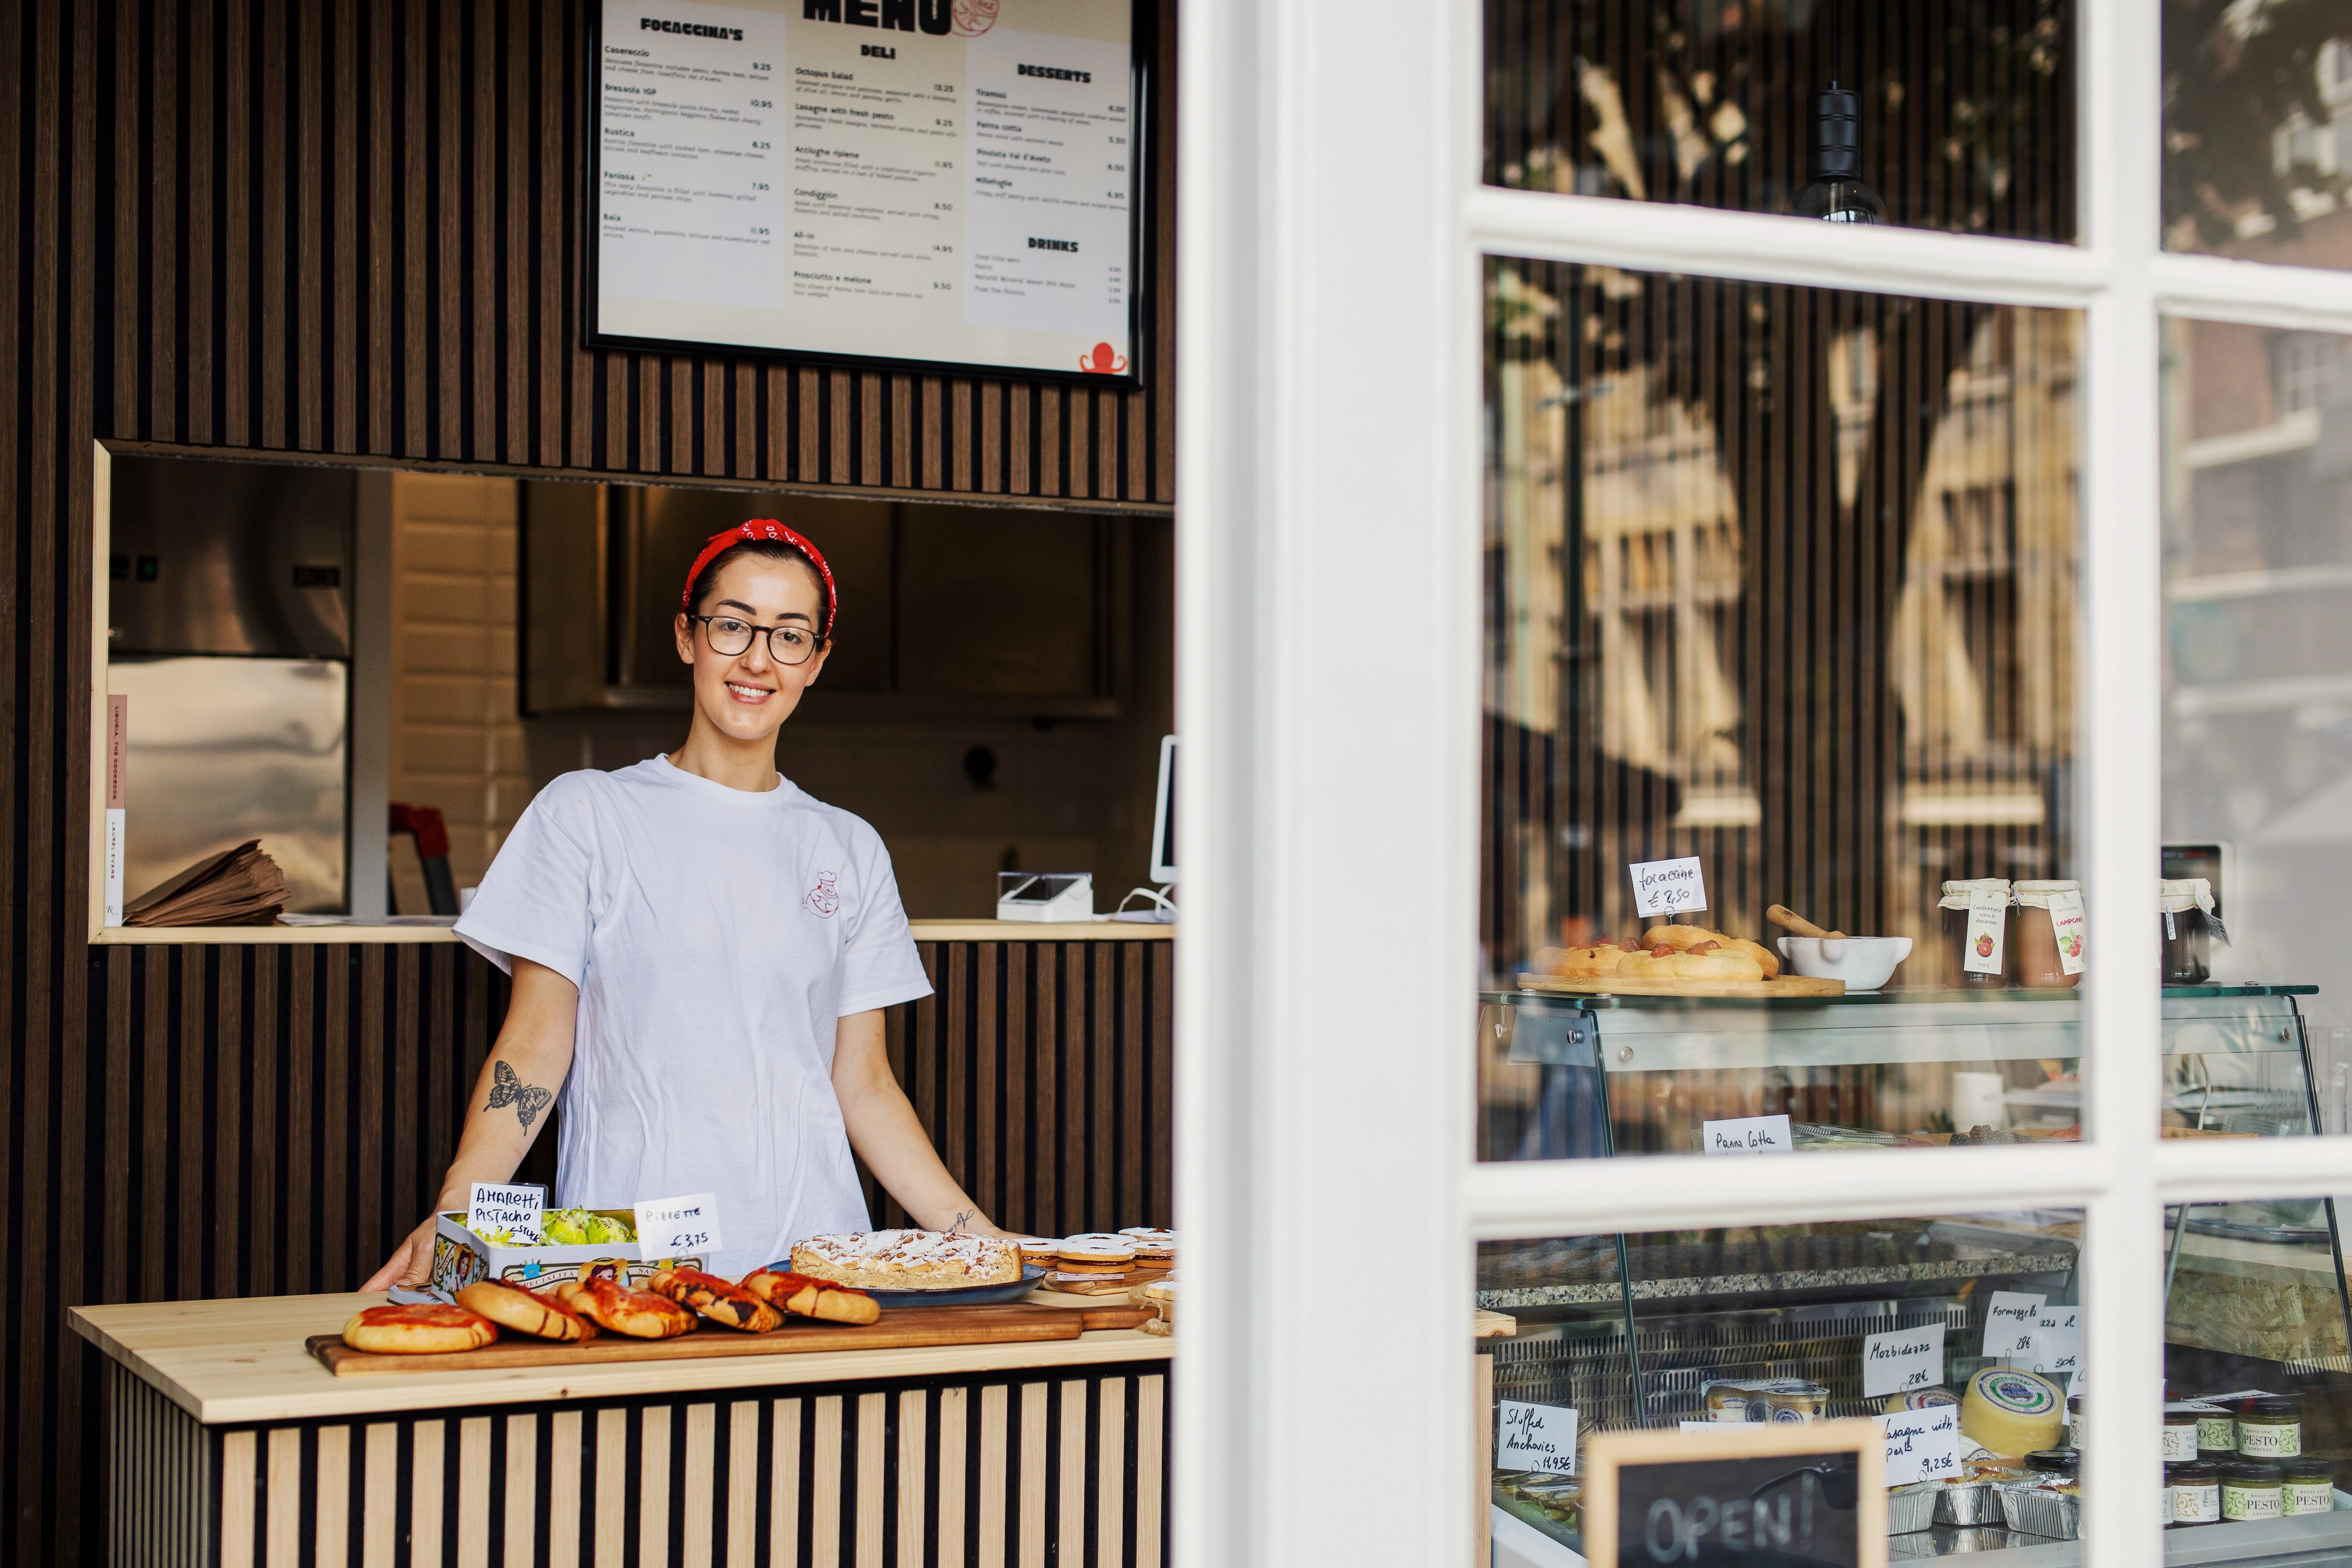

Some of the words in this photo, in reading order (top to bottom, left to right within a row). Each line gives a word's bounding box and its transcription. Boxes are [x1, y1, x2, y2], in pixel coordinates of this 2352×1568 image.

[803, 0, 952, 35] MENU
[641, 18, 743, 40] FOCACCINA'S
[860, 44, 896, 59] DELI
[1017, 64, 1091, 83] DESSERTS
[1028, 237, 1078, 253] DRINKS
[1973, 904, 2002, 913] Confettura
[2056, 916, 2084, 927] LAMPONE
[1716, 1132, 1744, 1148] Panna
[1748, 1130, 1776, 1148] Cotta
[1908, 1369, 1929, 1385] 28€
[1506, 1408, 1544, 1436] Stuffed
[1931, 1415, 1953, 1432] with
[1506, 1433, 1555, 1454] Anchovies
[2243, 1434, 2278, 1446] PESTO
[2247, 1499, 2279, 1510] PESTO
[2295, 1495, 2329, 1506] PESTO
